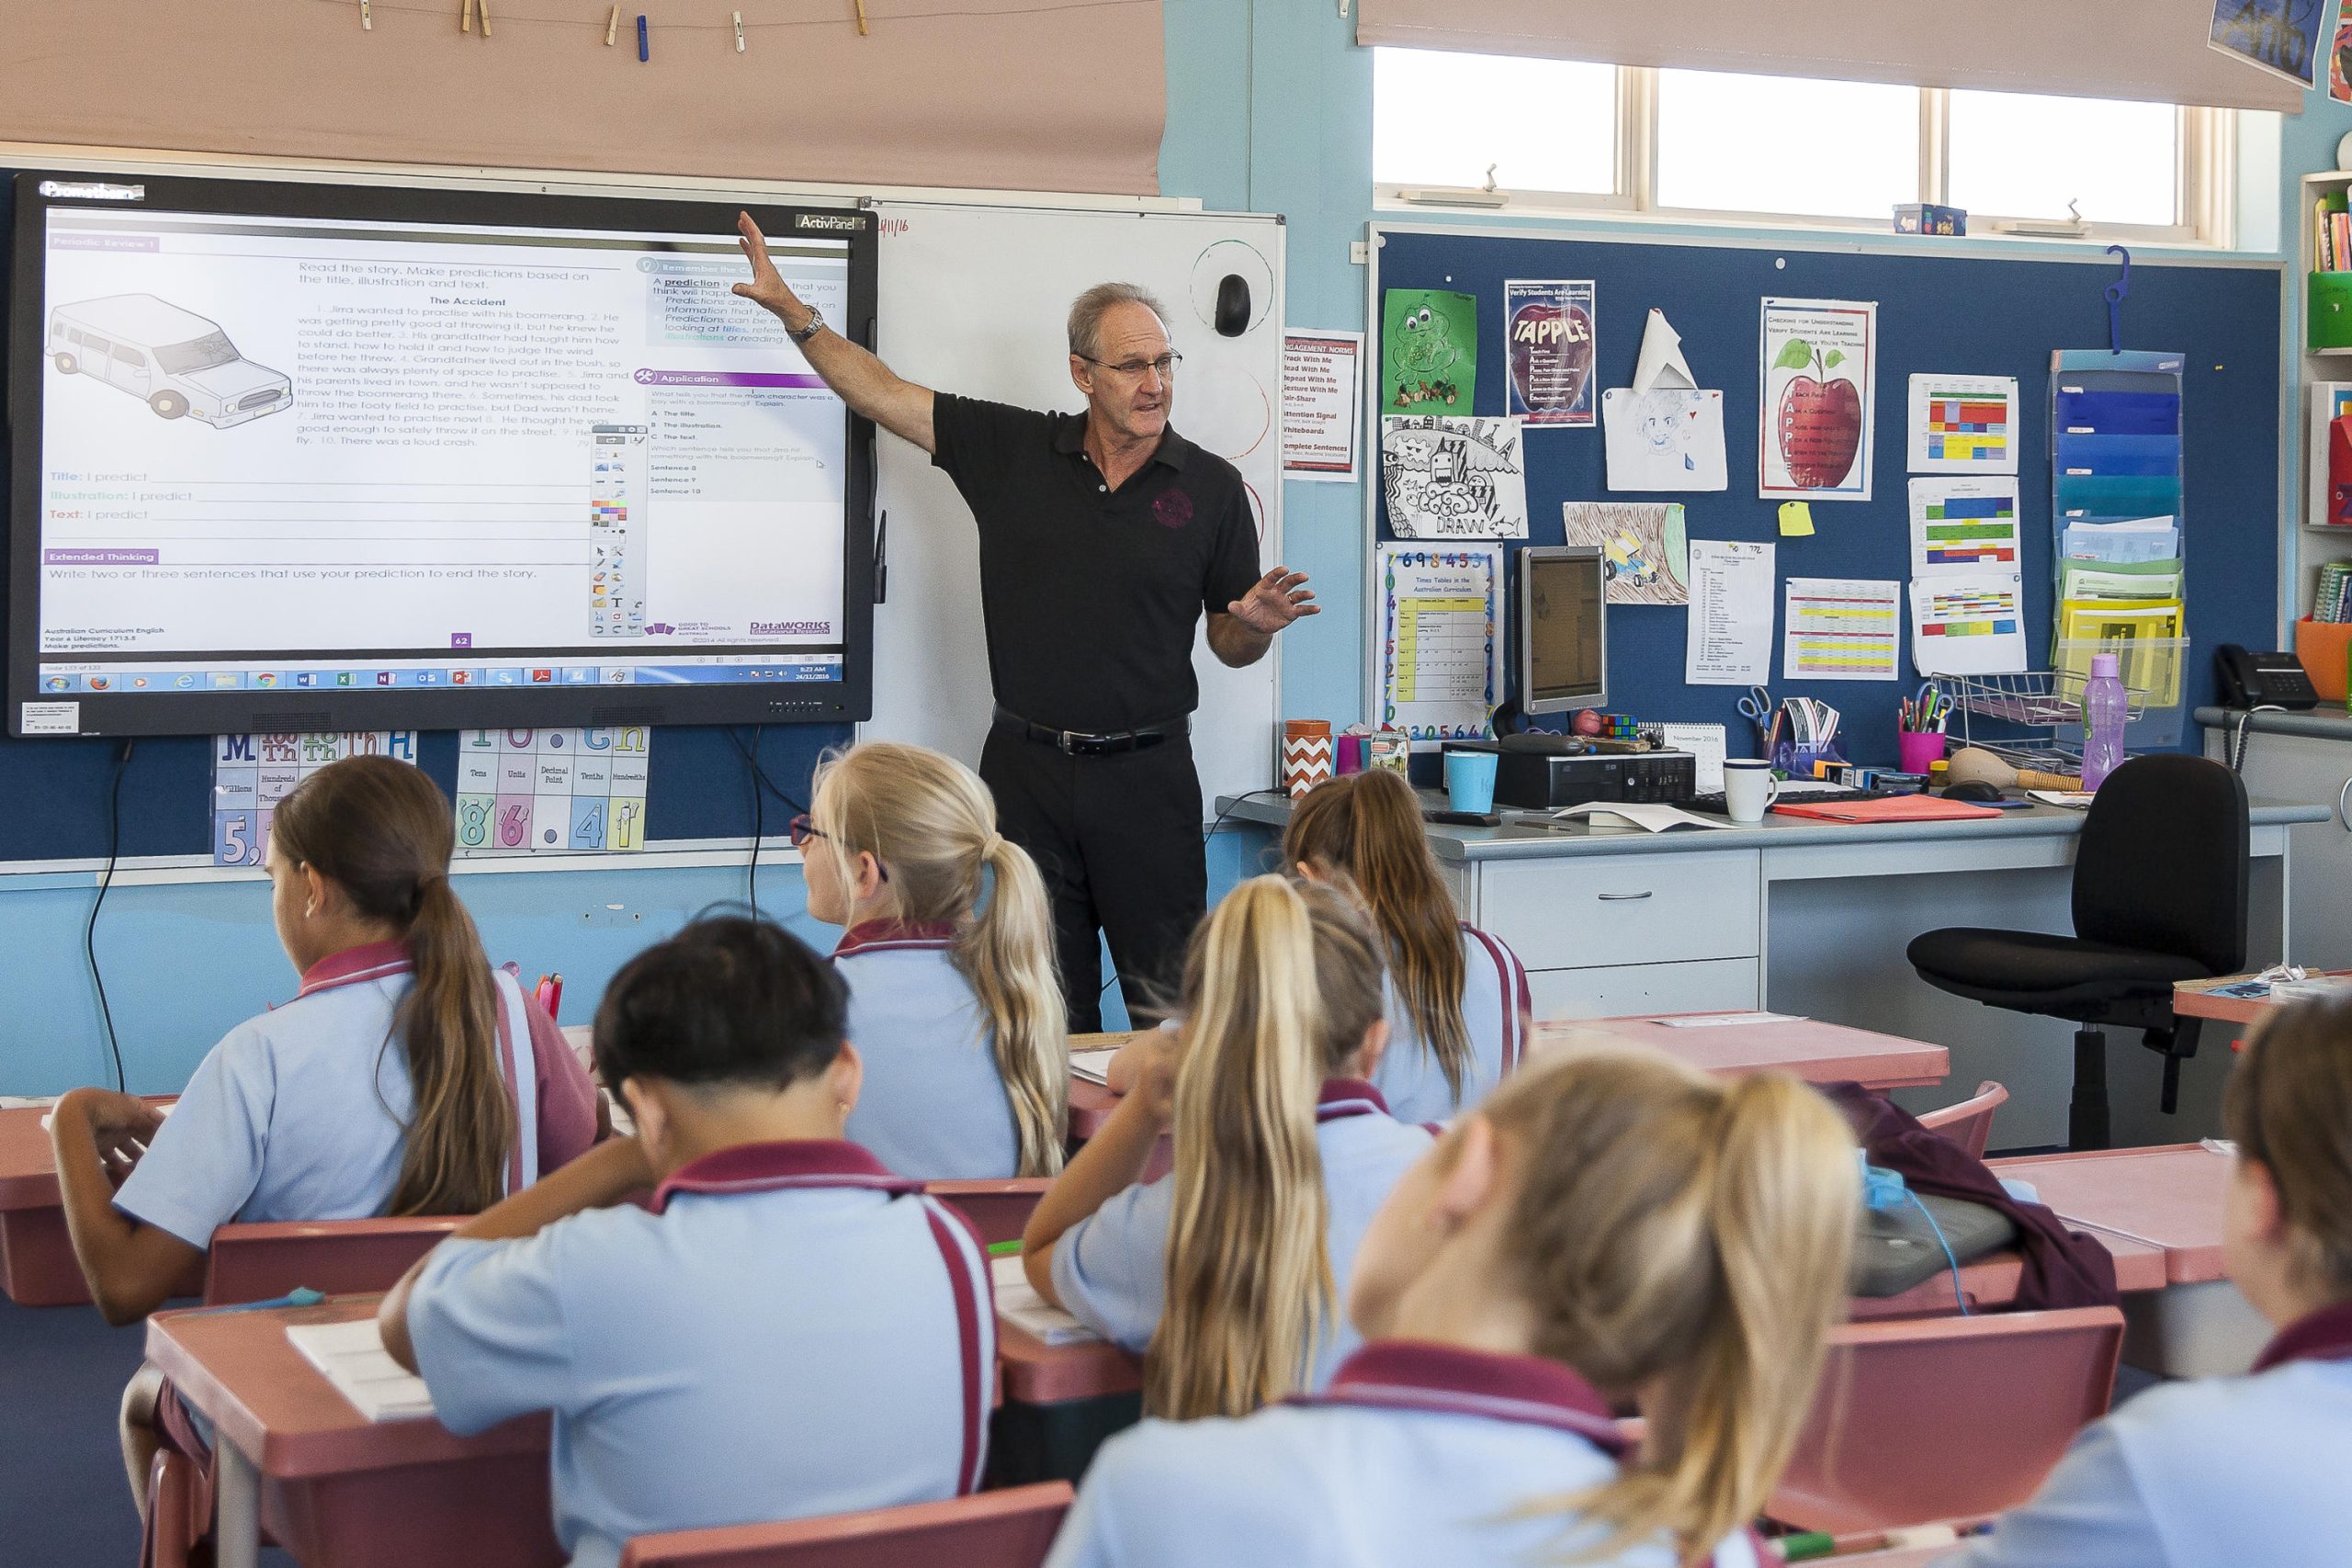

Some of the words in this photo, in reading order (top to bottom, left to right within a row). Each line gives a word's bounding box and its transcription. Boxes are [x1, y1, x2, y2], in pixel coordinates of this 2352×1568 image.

[800, 214, 854, 230] ActivPanel
[53, 237, 100, 246] Periodic
[105, 239, 145, 248] Review
[149, 239, 154, 248] 1
[299, 262, 336, 272] Read
[341, 264, 363, 273] the
[367, 264, 401, 277] story.
[406, 265, 445, 276] Make
[448, 267, 523, 280] predictions
[526, 269, 568, 280] based
[299, 274, 322, 284] the
[326, 275, 354, 286] title,
[357, 276, 424, 288] illustration
[428, 277, 456, 288] and
[460, 279, 489, 289] text.
[664, 277, 720, 288] prediction
[430, 296, 449, 305] The
[453, 296, 505, 306] Accident
[665, 314, 724, 323] Predictions
[752, 317, 766, 325] be
[664, 323, 705, 333] looking
[707, 324, 719, 333] at
[1513, 320, 1589, 344] TAPPLE
[1303, 355, 1321, 364] With
[661, 375, 719, 385] Application
[1328, 387, 1339, 395] Me
[1316, 412, 1337, 421] Signal
[296, 435, 311, 447] fly.
[321, 435, 334, 445] 10.
[341, 435, 372, 445] There
[413, 436, 440, 446] loud
[443, 437, 477, 446] crash.
[1284, 443, 1312, 452] omplete
[51, 472, 83, 480] Title:
[86, 472, 91, 480] I
[95, 472, 147, 482] predict
[50, 491, 129, 500] Illustration:
[131, 491, 136, 500] I
[140, 491, 192, 502] predict
[95, 511, 147, 520] predict
[1436, 516, 1485, 534] DRAW
[107, 553, 154, 563] Thinking
[1387, 553, 1397, 568] 7
[1402, 553, 1412, 568] 6
[1416, 553, 1425, 568] 9
[1430, 553, 1440, 568] 8
[1445, 553, 1455, 568] 4
[1459, 553, 1468, 568] 5
[1472, 553, 1481, 568] 3
[1487, 553, 1493, 566] 1
[50, 570, 85, 578] Write
[91, 570, 118, 578] two
[141, 570, 179, 578] three
[183, 569, 256, 578] sentences
[260, 569, 288, 578] that
[320, 571, 350, 580] your
[354, 569, 424, 580] prediction
[428, 569, 443, 578] to
[446, 569, 473, 578] end
[478, 569, 499, 578] the
[503, 569, 537, 580] story.
[750, 621, 831, 629] DataWORKS
[1410, 726, 1420, 740] 3
[1425, 726, 1436, 740] 0
[1441, 725, 1450, 740] 5
[1455, 725, 1464, 739] 6
[1469, 724, 1479, 739] 4
[508, 771, 526, 779] Units
[541, 766, 569, 774] Decimal
[545, 775, 563, 784] Point
[581, 773, 605, 781] Tenths
[460, 805, 486, 846] 8
[501, 805, 524, 847] 6
[576, 805, 602, 848] 4
